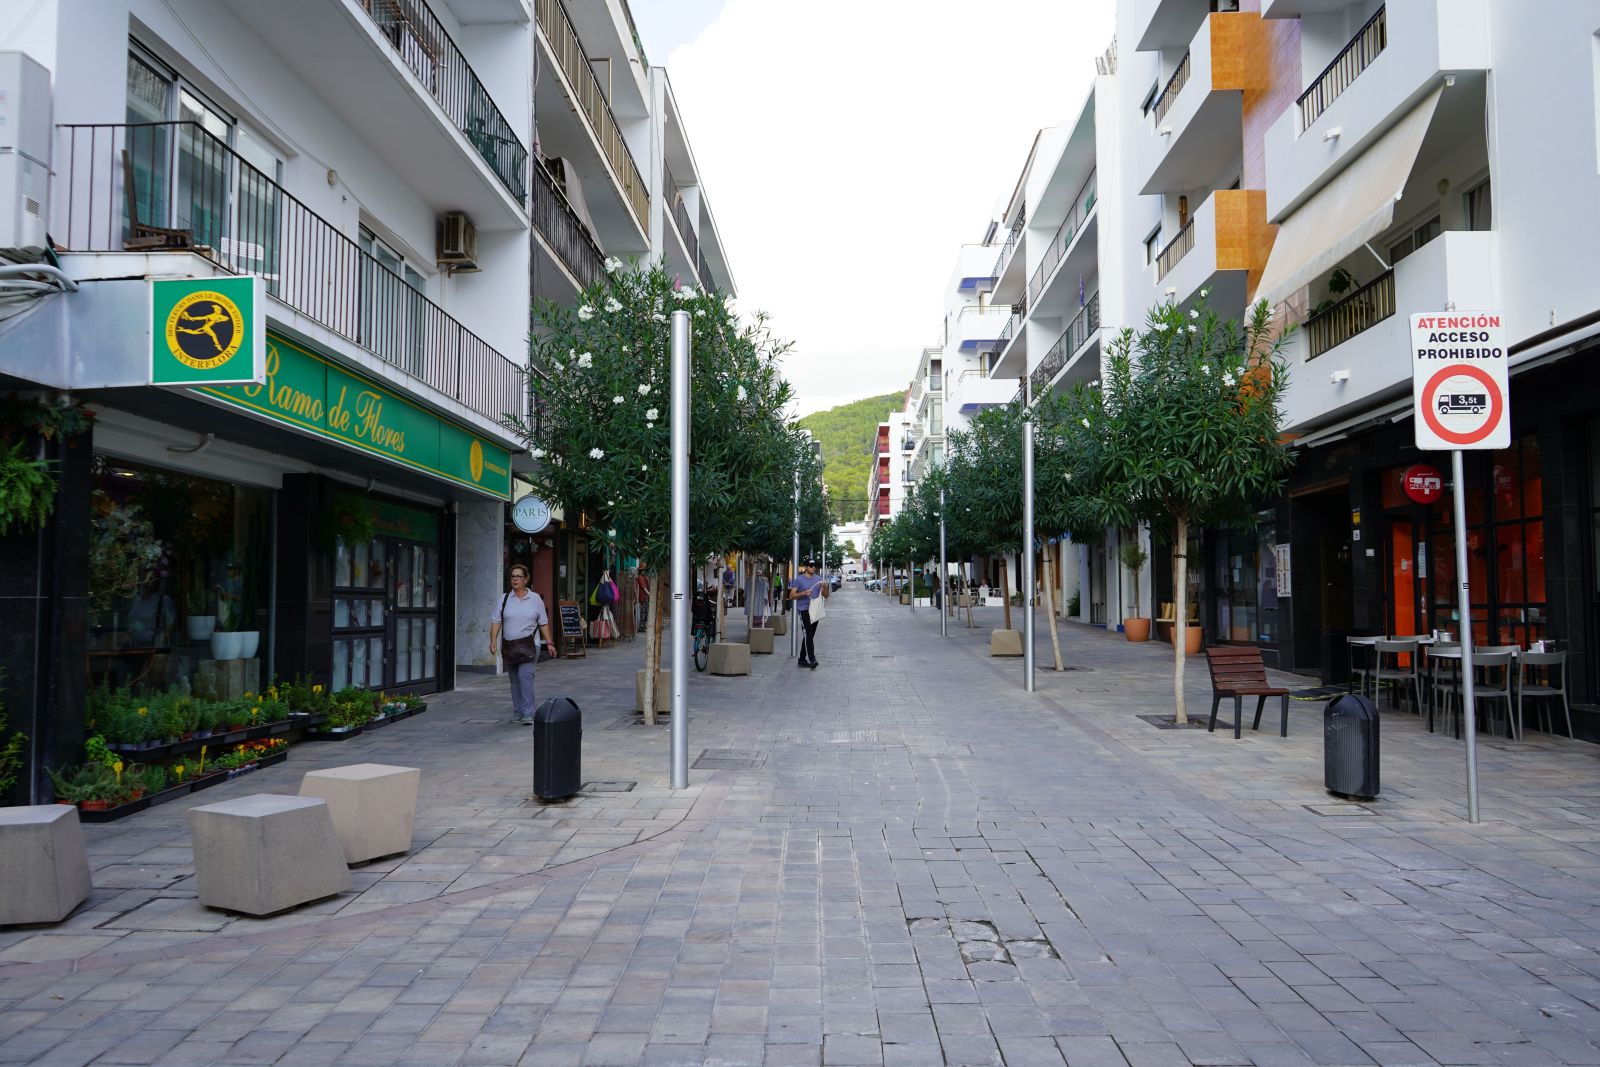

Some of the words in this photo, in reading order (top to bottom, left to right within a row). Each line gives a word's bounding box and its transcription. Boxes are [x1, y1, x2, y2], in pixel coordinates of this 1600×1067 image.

[1417, 314, 1500, 329] ATENCIÓN
[1428, 331, 1490, 343] ACCESO
[172, 345, 238, 369] INTERFLORA
[1417, 347, 1502, 360] PROHIBIDO
[1458, 395, 1478, 406] 3,5t
[328, 385, 350, 432] de
[354, 390, 405, 453] Flores
[515, 508, 546, 517] PARIS
